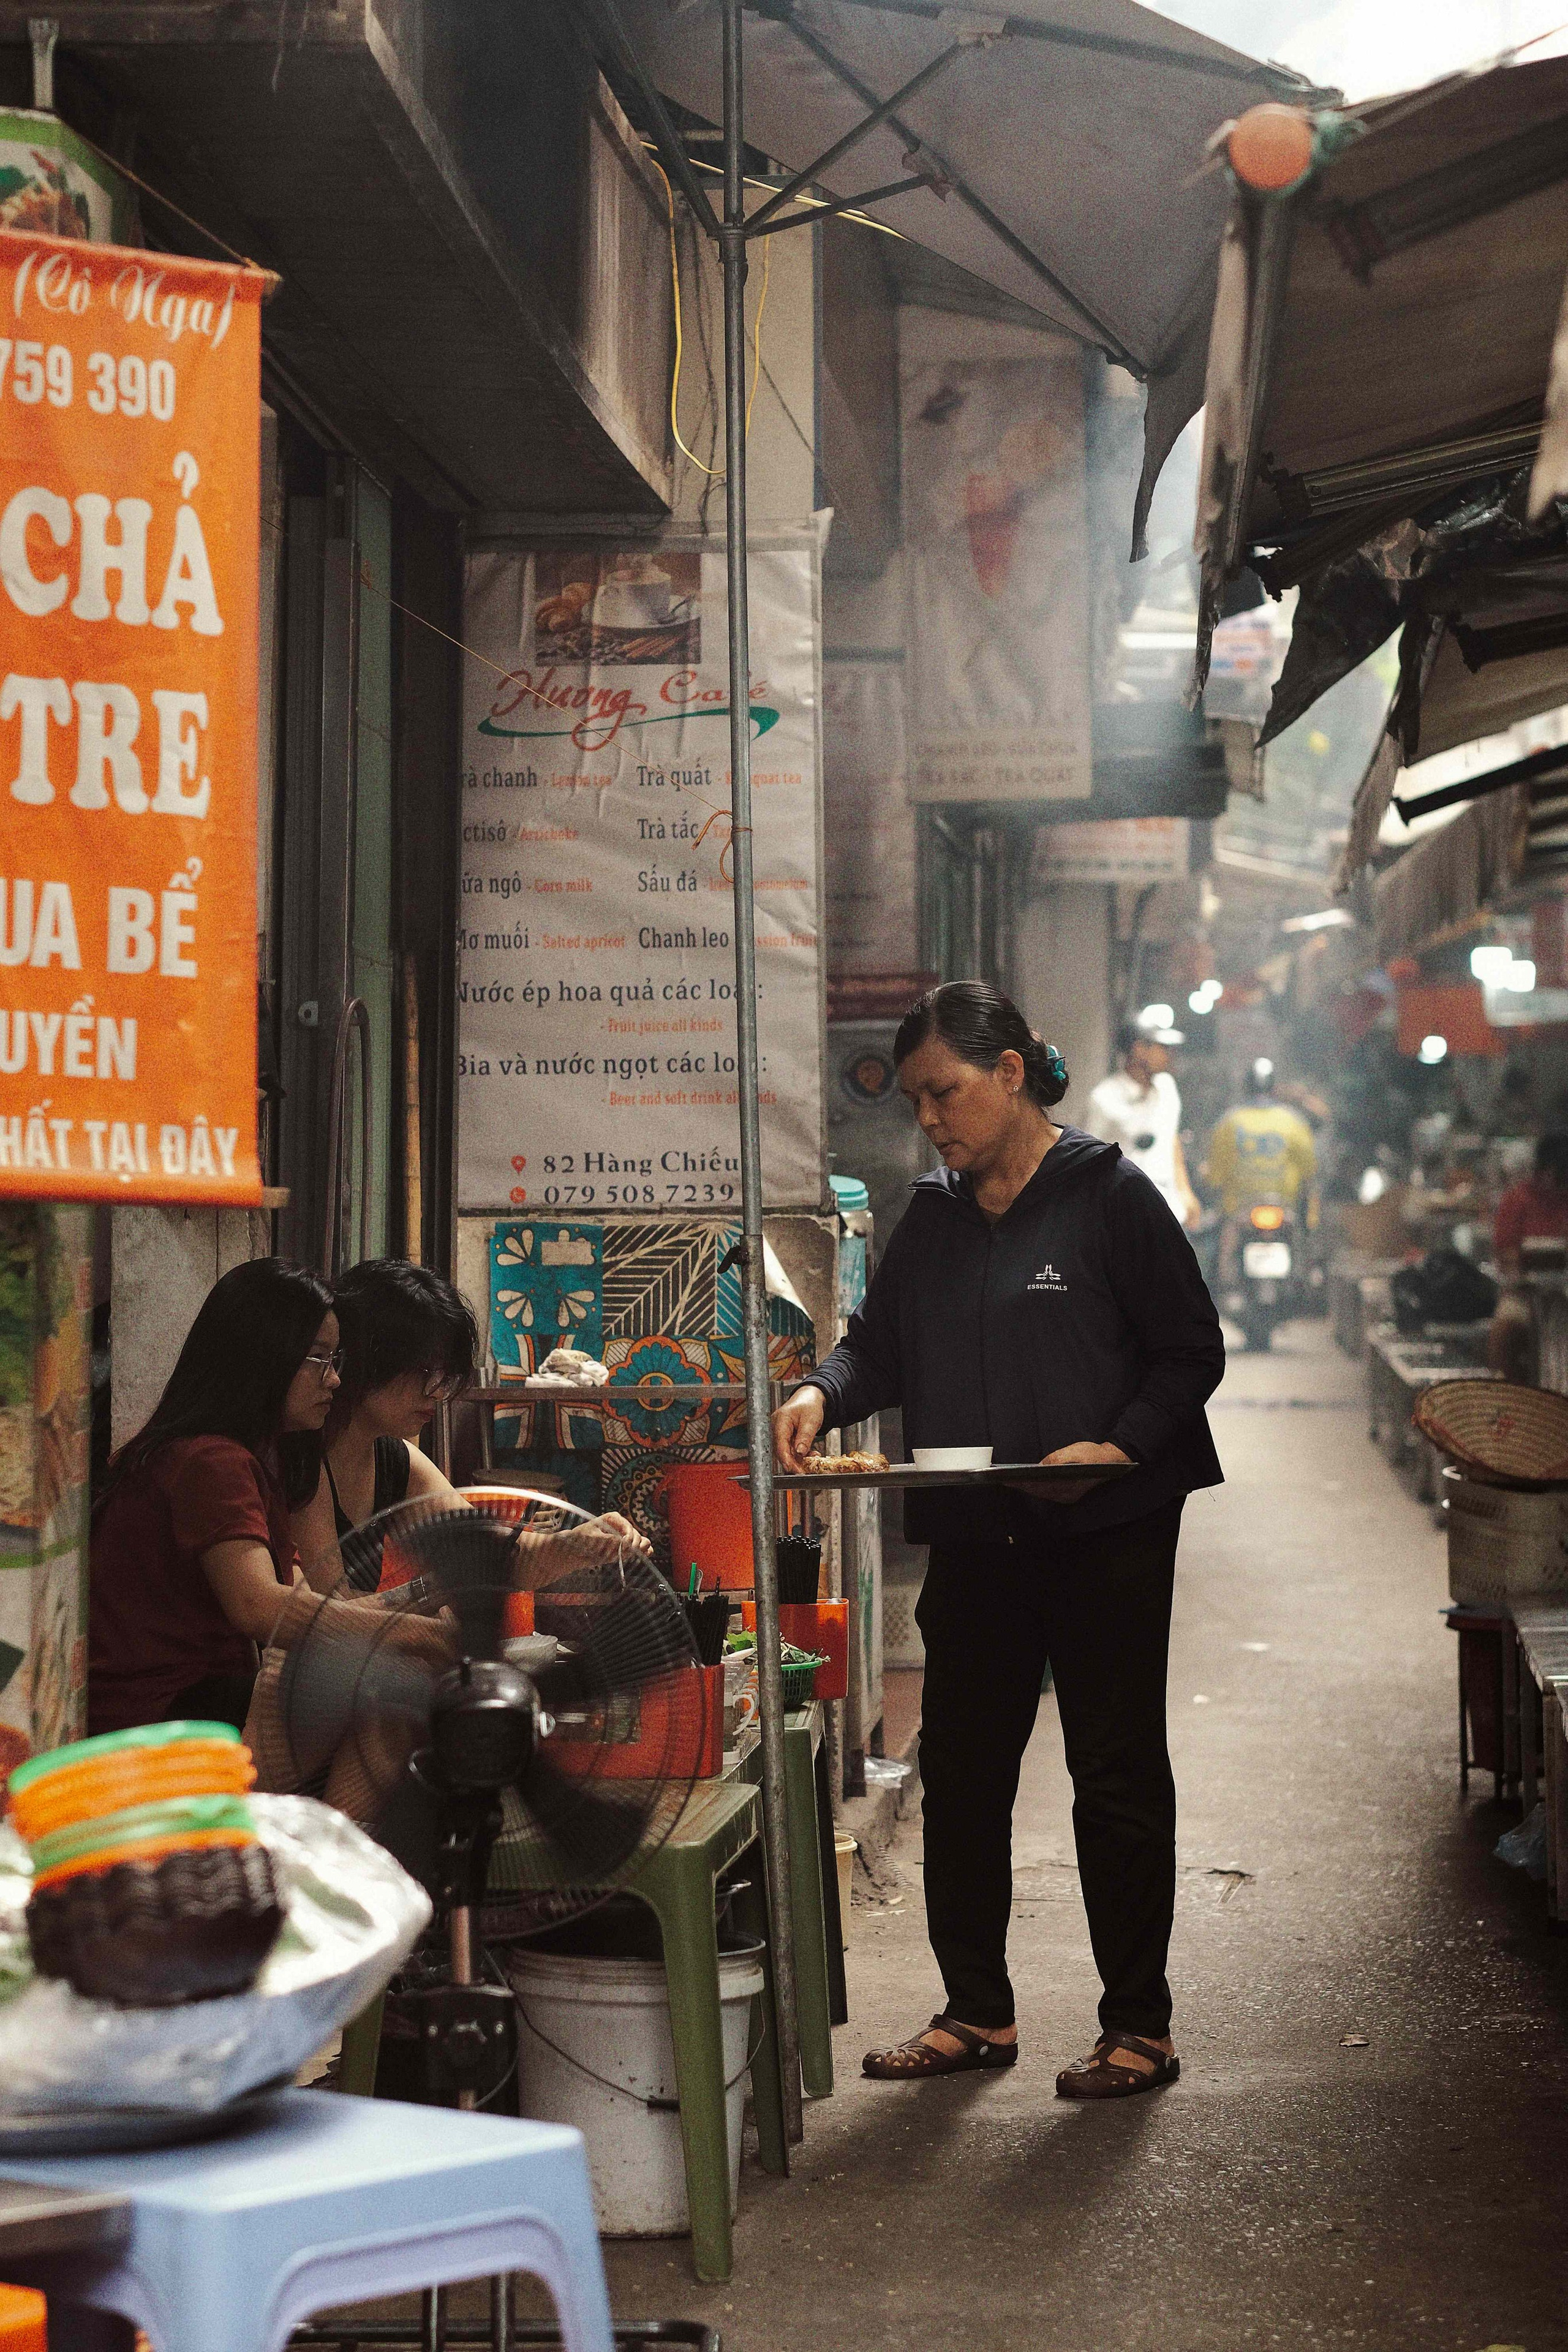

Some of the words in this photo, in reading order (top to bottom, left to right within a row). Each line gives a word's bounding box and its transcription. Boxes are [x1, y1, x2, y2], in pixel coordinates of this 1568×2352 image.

[88, 352, 175, 421] 390
[0, 451, 224, 636] CHẢ
[660, 669, 767, 704] Caé
[1, 673, 211, 819] TRE
[483, 766, 537, 787] chanh
[637, 764, 665, 786] Trà
[671, 755, 712, 792] quất
[636, 819, 665, 839] Trà
[673, 811, 699, 839] tắc
[489, 870, 521, 899] ngô
[638, 864, 669, 892] Sấu
[677, 870, 697, 892] đá
[107, 856, 203, 978] BỂ
[484, 921, 529, 949] muối
[638, 927, 696, 948] Chanh
[703, 927, 729, 948] leo
[522, 980, 550, 1008] ép
[559, 981, 601, 1002] hoa
[610, 978, 654, 1006] quả
[663, 978, 701, 1000] các
[499, 1052, 527, 1075] và
[535, 1052, 595, 1074] nước
[603, 1056, 658, 1080] ngọt
[667, 1050, 705, 1072] các
[640, 1090, 661, 1105] and
[691, 1090, 722, 1104] drink
[83, 1120, 149, 1183] TẠI
[159, 1114, 239, 1177] ĐÂY
[543, 1155, 575, 1174] 82
[584, 1152, 653, 1177] Hàng
[661, 1146, 739, 1172] Chiếu
[545, 1185, 595, 1204] 079
[606, 1185, 655, 1204] 508
[666, 1184, 734, 1203] 7239
